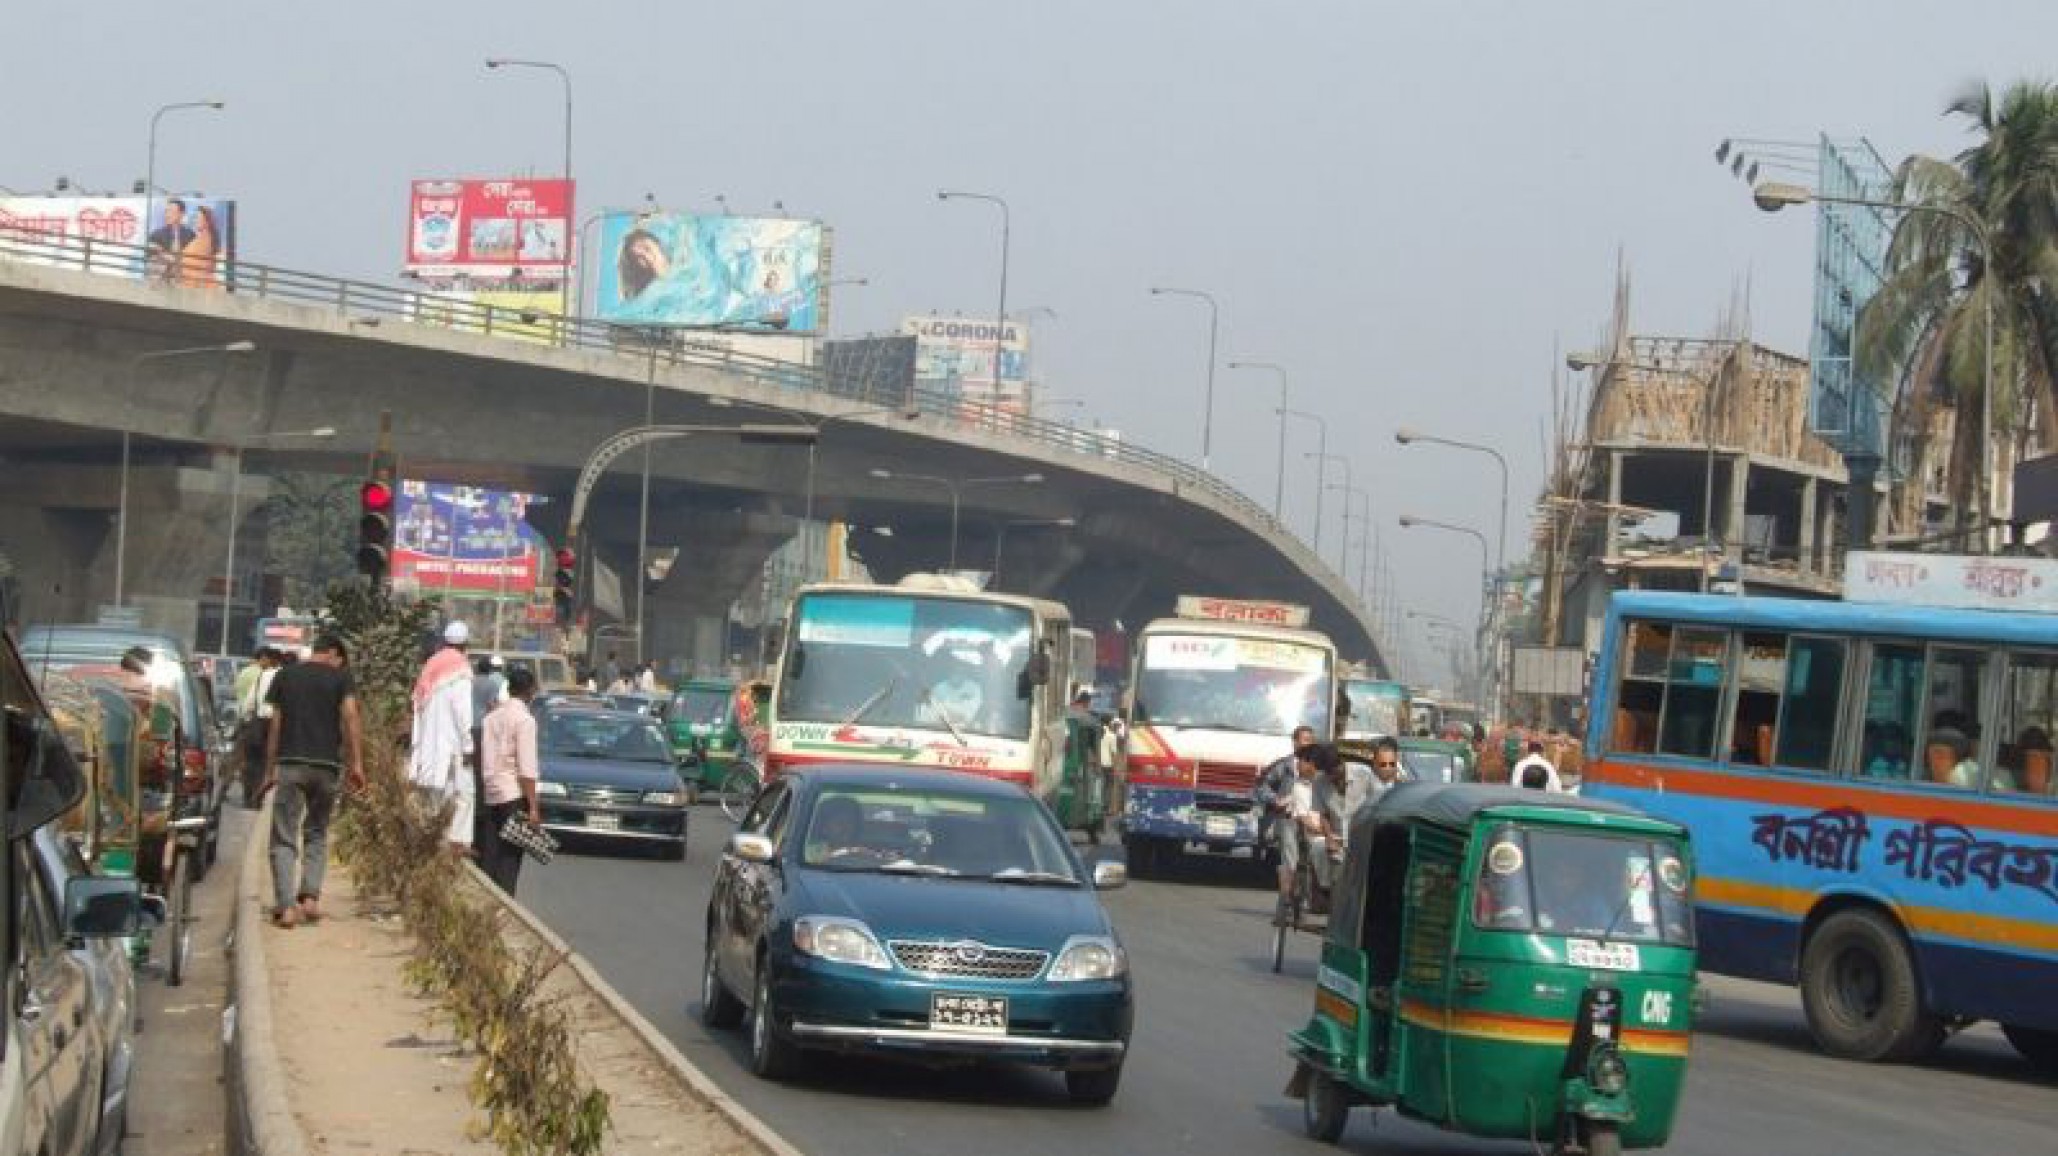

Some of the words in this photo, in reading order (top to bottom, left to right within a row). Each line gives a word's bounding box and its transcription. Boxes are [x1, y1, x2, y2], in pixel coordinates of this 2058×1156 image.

[931, 321, 1017, 343] CORONA
[1750, 805, 1871, 873] বনশ্রী
[1885, 818, 2058, 904] পরিবহ
[1641, 990, 1673, 1024] CNG
